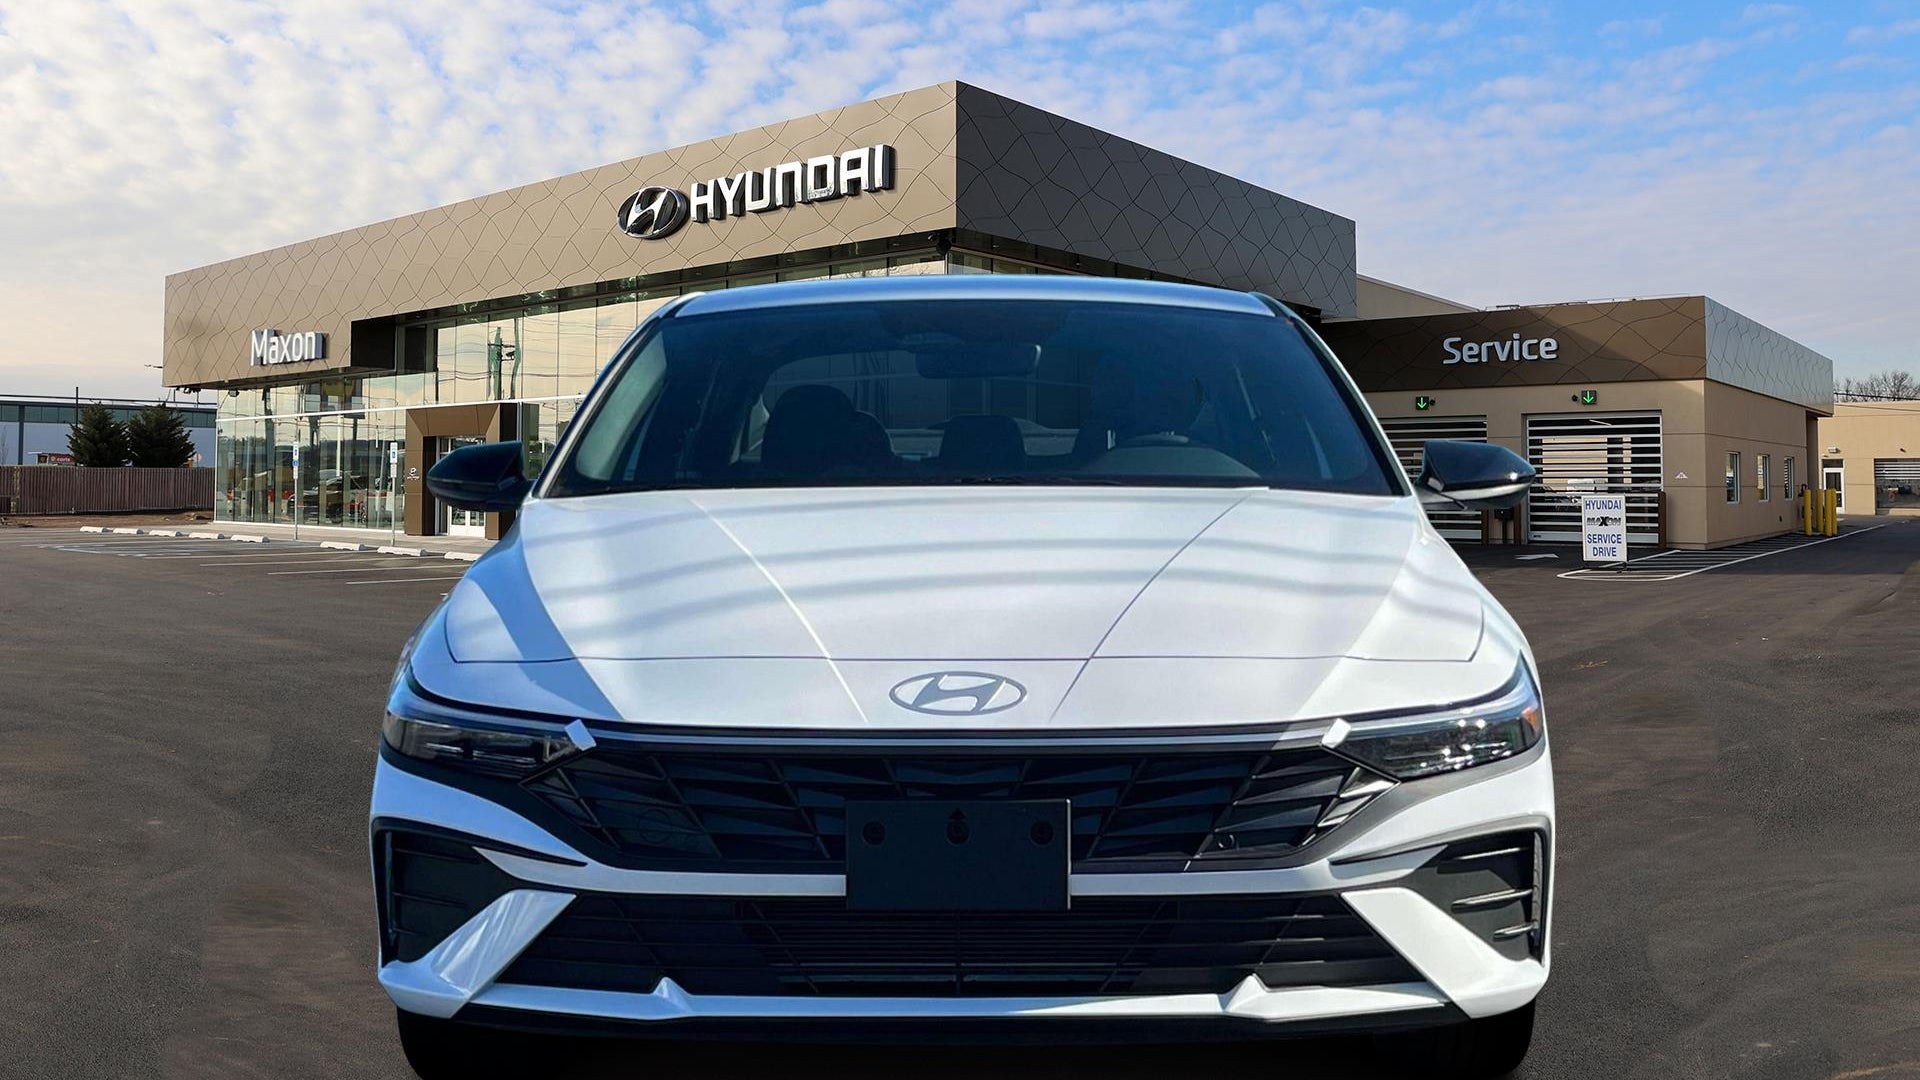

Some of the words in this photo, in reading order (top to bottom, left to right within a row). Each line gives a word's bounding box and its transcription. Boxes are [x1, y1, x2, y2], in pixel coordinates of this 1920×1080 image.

[690, 144, 891, 223] HYUNDAI
[250, 328, 324, 367] Maxon
[1443, 333, 1558, 364] Service
[1585, 500, 1622, 510] HYUNDAI
[1587, 533, 1622, 544] SERVICE
[1592, 547, 1617, 557] DRIVE
